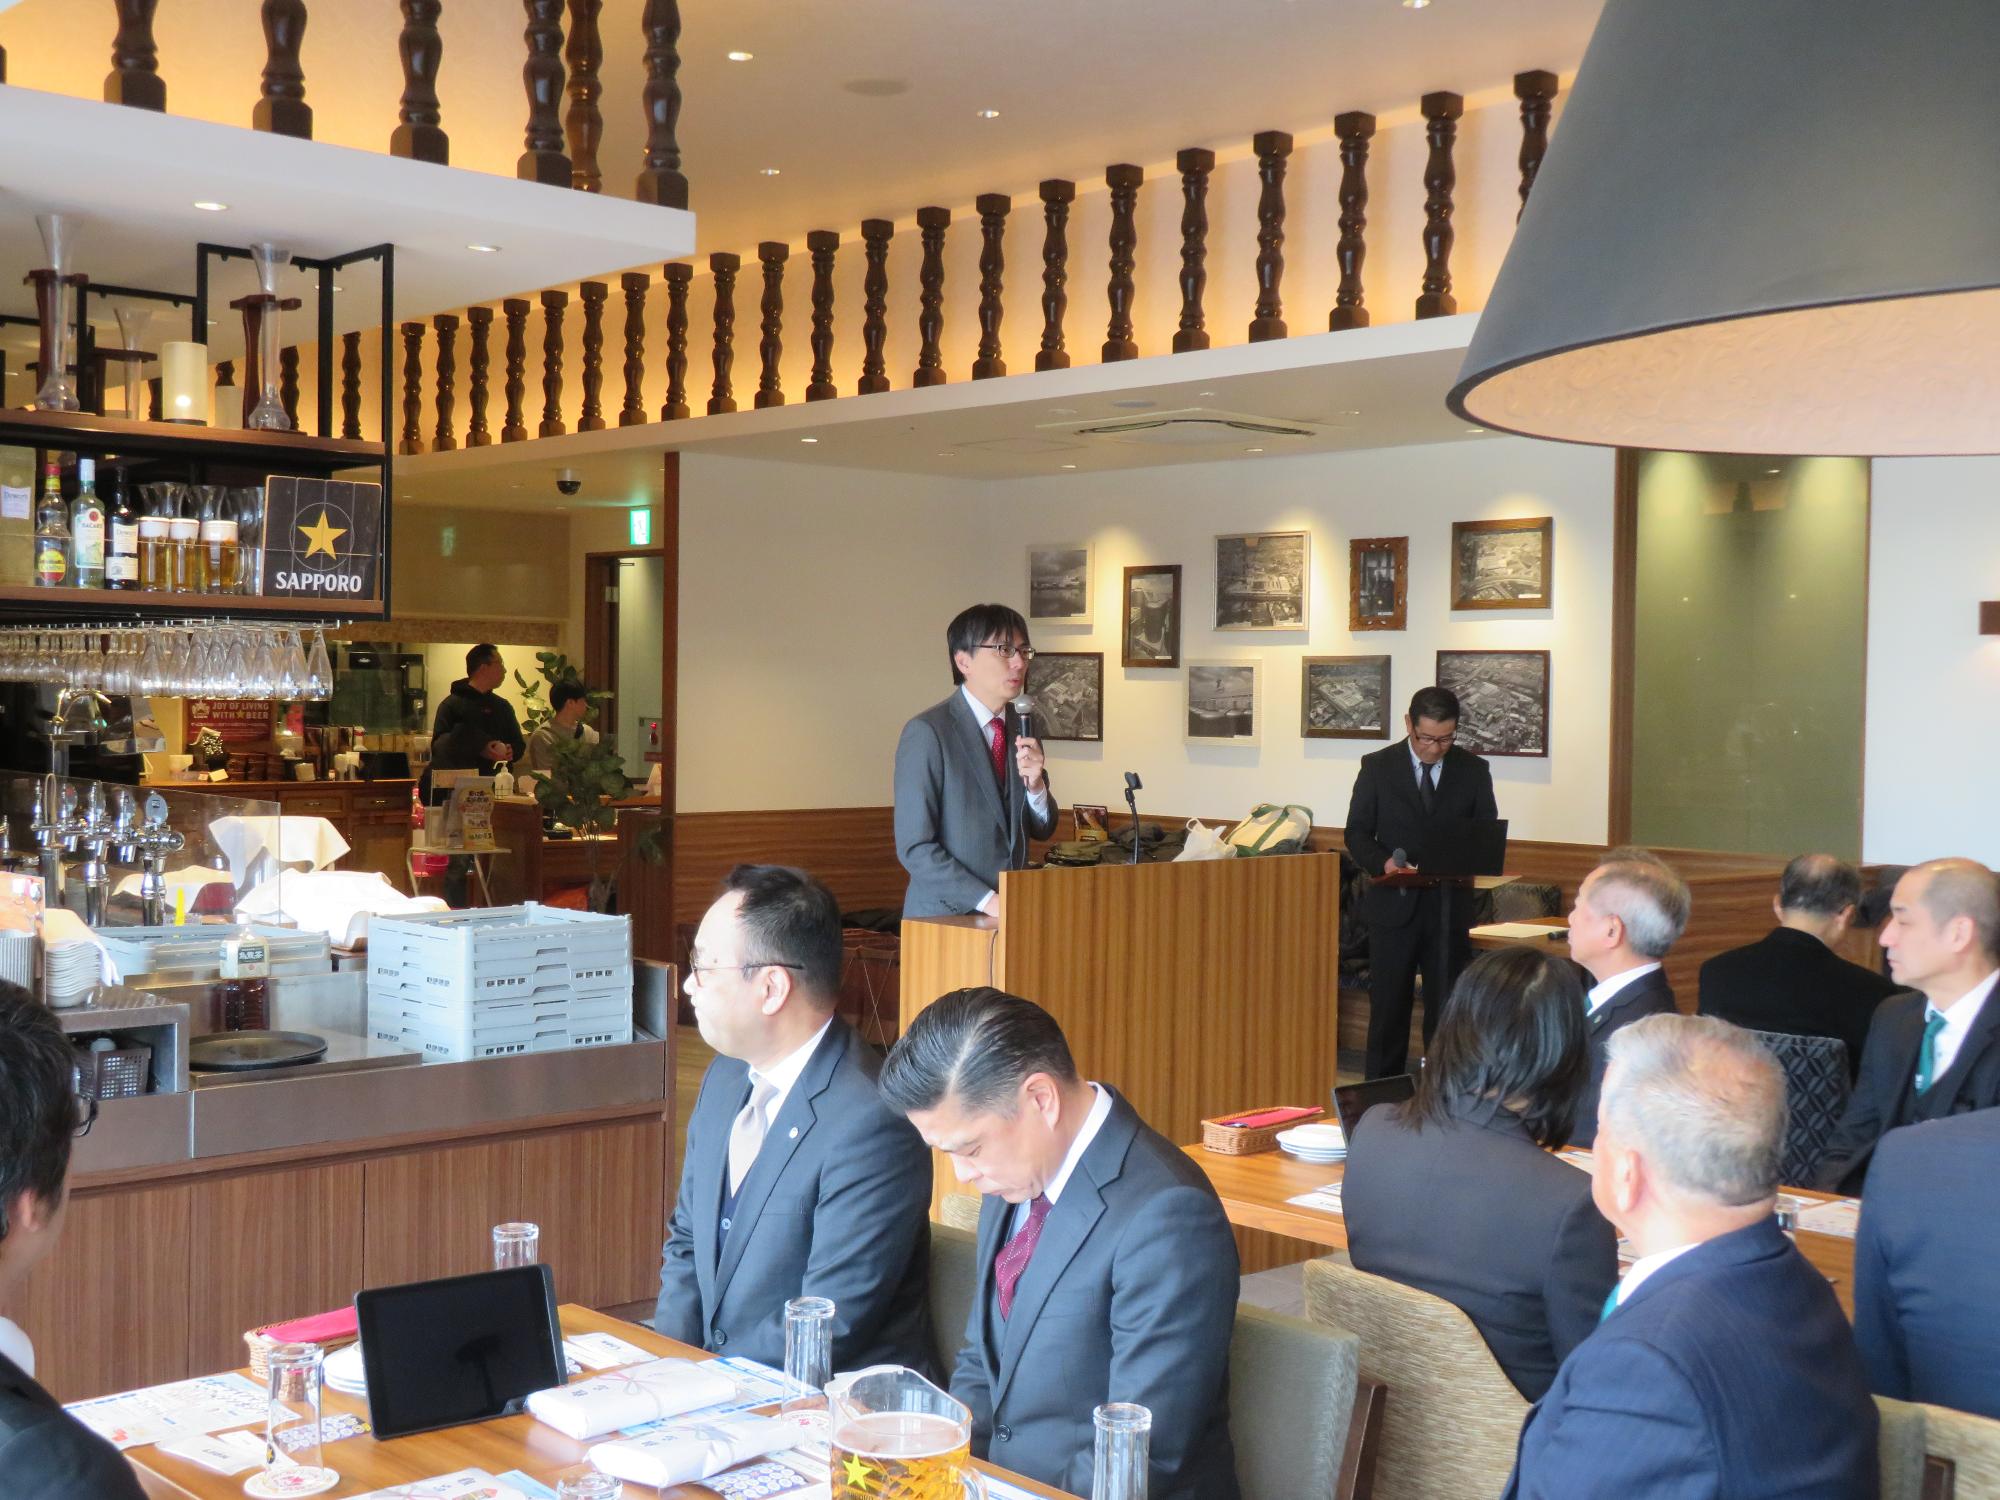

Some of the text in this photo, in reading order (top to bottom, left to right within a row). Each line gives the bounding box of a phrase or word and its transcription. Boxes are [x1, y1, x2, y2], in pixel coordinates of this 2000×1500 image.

[275, 571, 362, 593] SAPPORO
[212, 702, 269, 710] JOY OF LIVING
[212, 711, 235, 719] WITH
[246, 711, 269, 719] BEER
[239, 950, 264, 960] 烏龍茶
